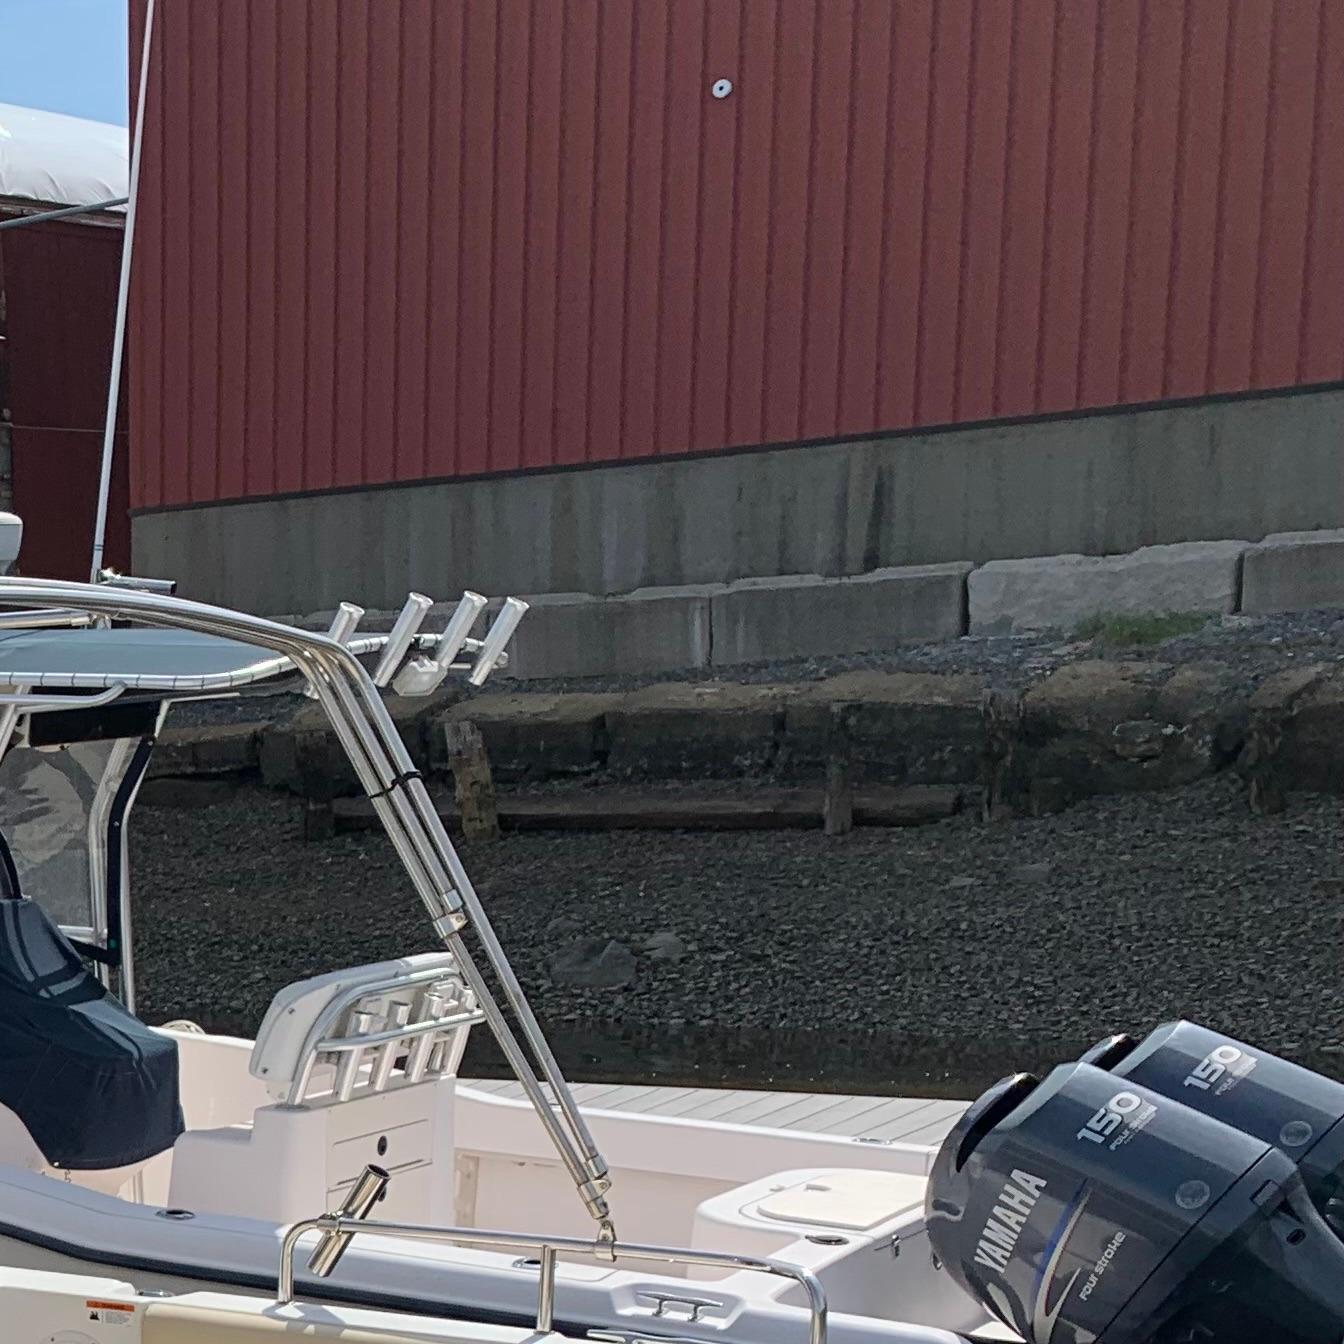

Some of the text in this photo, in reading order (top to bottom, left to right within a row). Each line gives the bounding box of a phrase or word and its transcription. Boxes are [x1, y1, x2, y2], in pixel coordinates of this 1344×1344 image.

[1183, 1045, 1242, 1090] 150
[1076, 1091, 1142, 1145] 150
[974, 1168, 1048, 1276] YAMAHA
